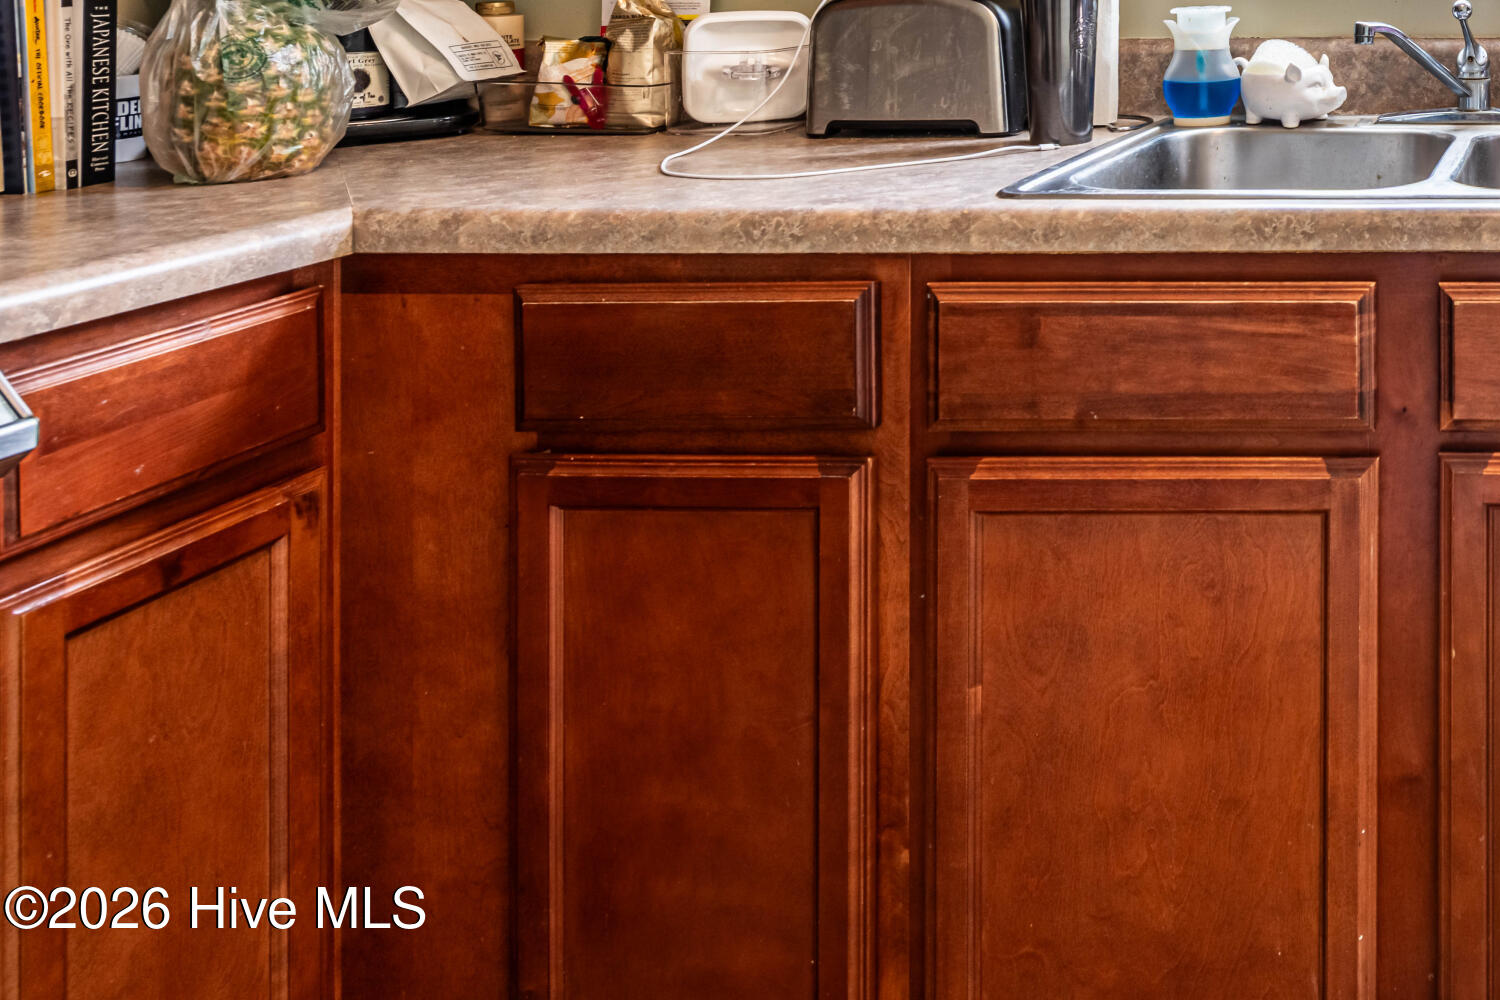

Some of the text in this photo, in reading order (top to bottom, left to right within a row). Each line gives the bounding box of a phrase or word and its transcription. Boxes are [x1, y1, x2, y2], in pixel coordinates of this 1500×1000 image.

[64, 33, 72, 50] One
[65, 51, 73, 69] with
[90, 13, 111, 153] JAPANESE KITCHEN
